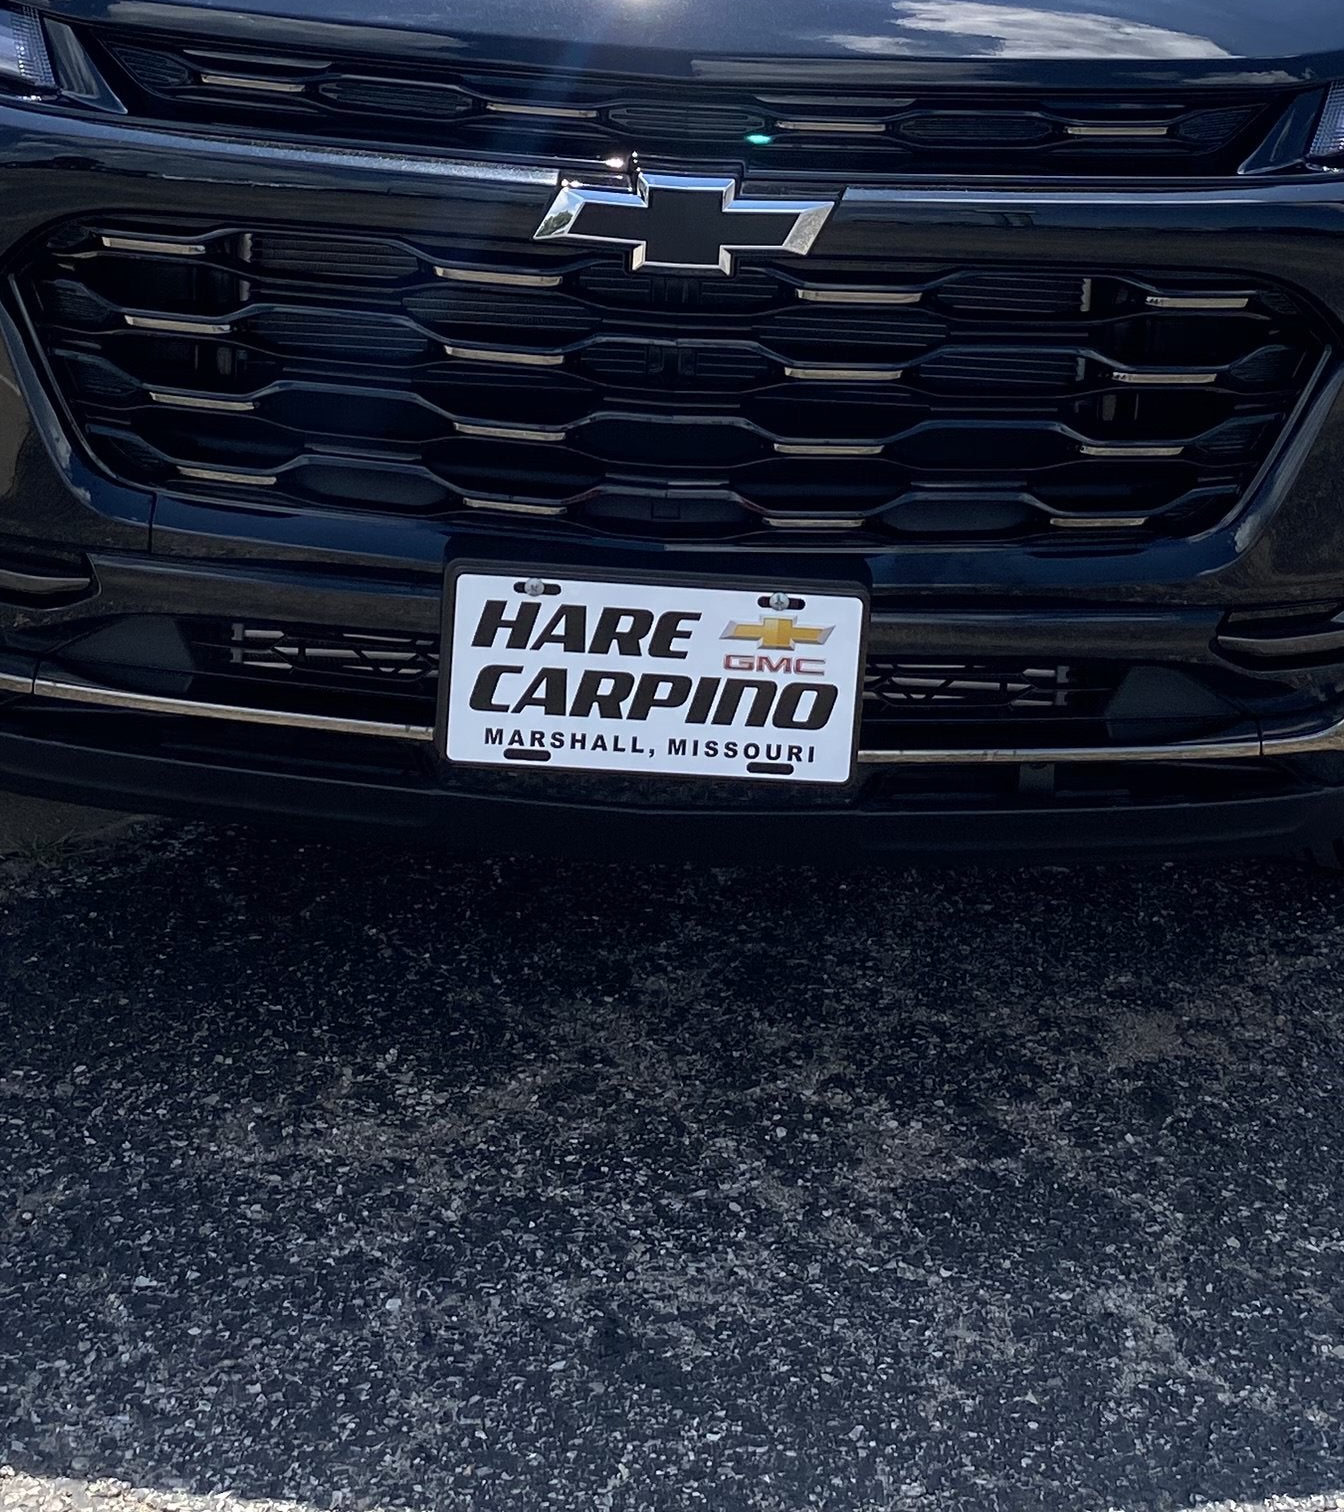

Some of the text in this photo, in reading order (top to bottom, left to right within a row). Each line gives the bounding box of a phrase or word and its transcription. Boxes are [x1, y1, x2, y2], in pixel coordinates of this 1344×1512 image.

[471, 599, 703, 660] HARE
[723, 653, 828, 677] GMC
[468, 663, 840, 731] CARPINO
[484, 726, 816, 764] MARSHALL, MISSOURI
